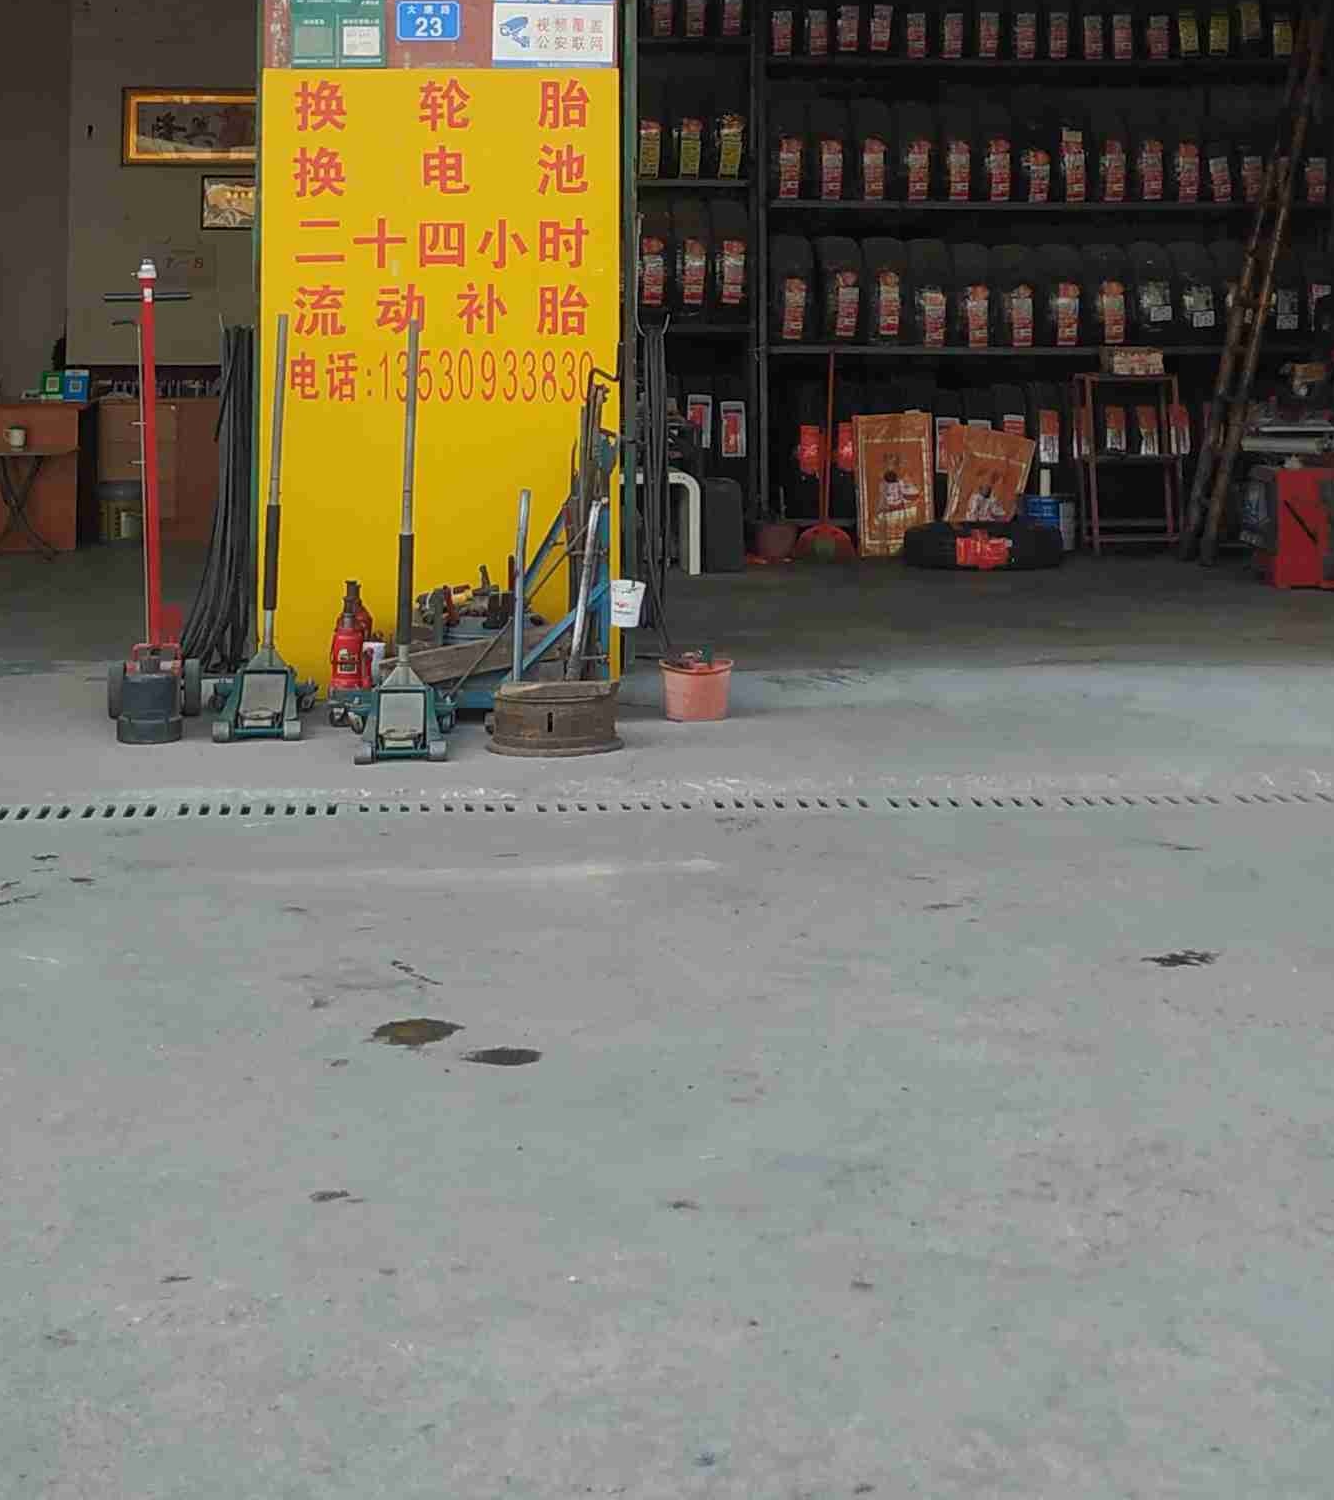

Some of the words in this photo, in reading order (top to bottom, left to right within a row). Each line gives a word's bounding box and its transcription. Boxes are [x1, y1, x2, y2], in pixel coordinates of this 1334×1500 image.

[414, 17, 444, 37] 23
[293, 78, 589, 132] 换轮胎
[292, 144, 589, 198] 换电池
[294, 217, 589, 270] 二十四小时
[293, 282, 589, 337] 流动补胎
